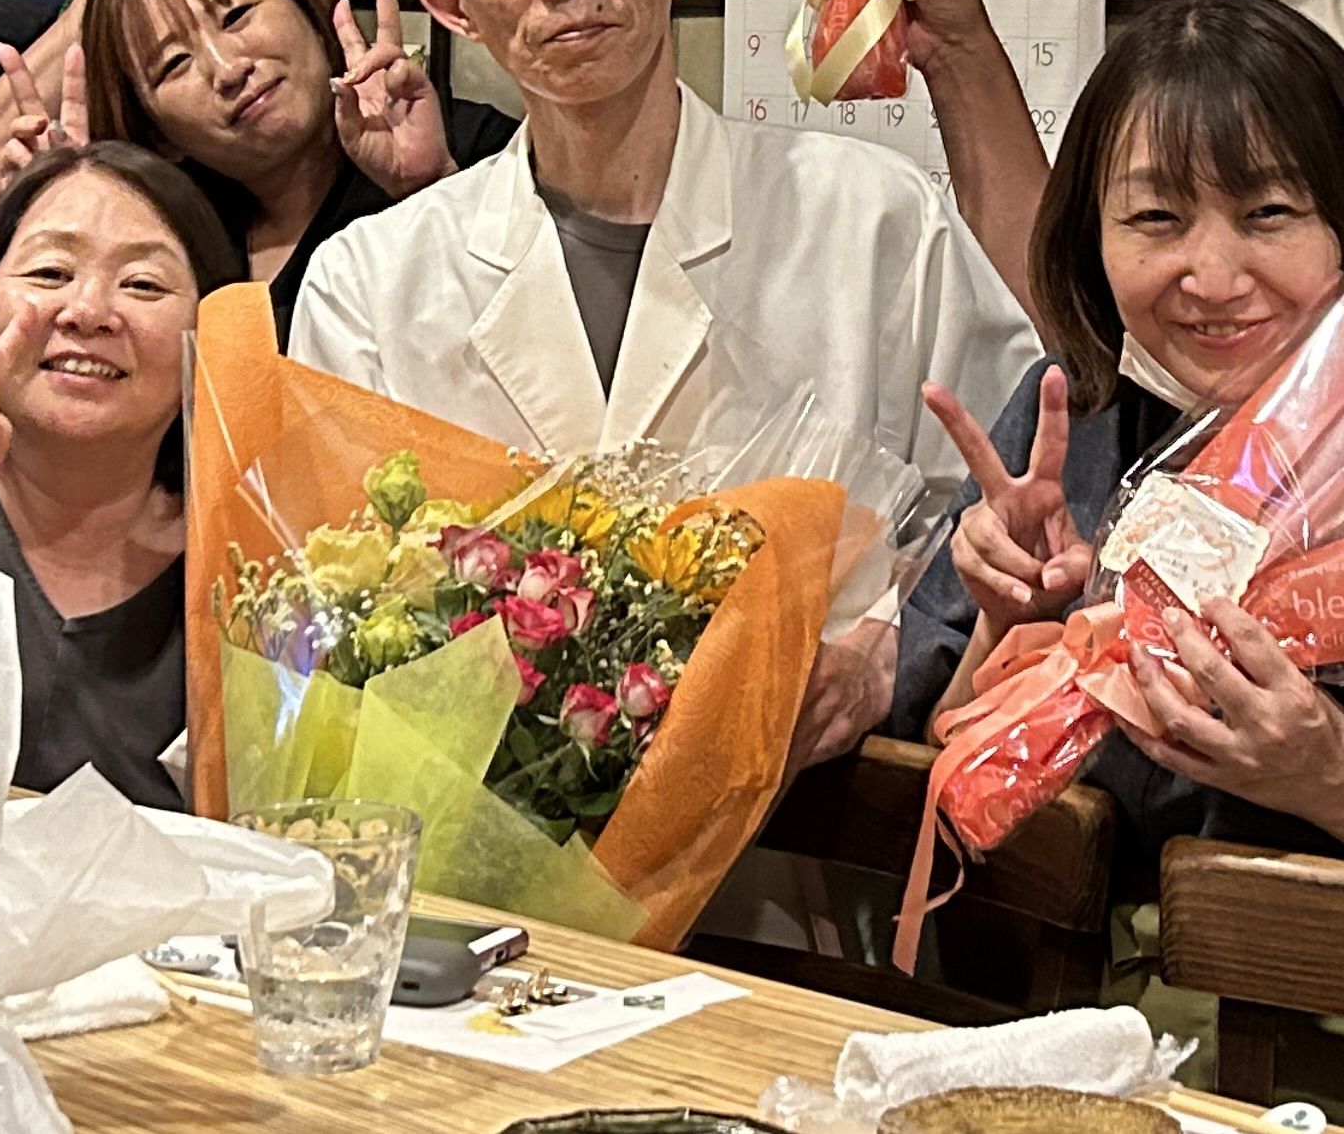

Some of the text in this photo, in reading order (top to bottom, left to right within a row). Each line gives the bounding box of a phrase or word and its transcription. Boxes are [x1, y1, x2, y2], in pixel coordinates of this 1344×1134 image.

[748, 35, 1054, 67] 9 15
[746, 99, 767, 122] 16
[791, 101, 809, 124] 17
[838, 103, 856, 125] 18
[885, 104, 905, 127] 19
[1030, 110, 1056, 135] 22
